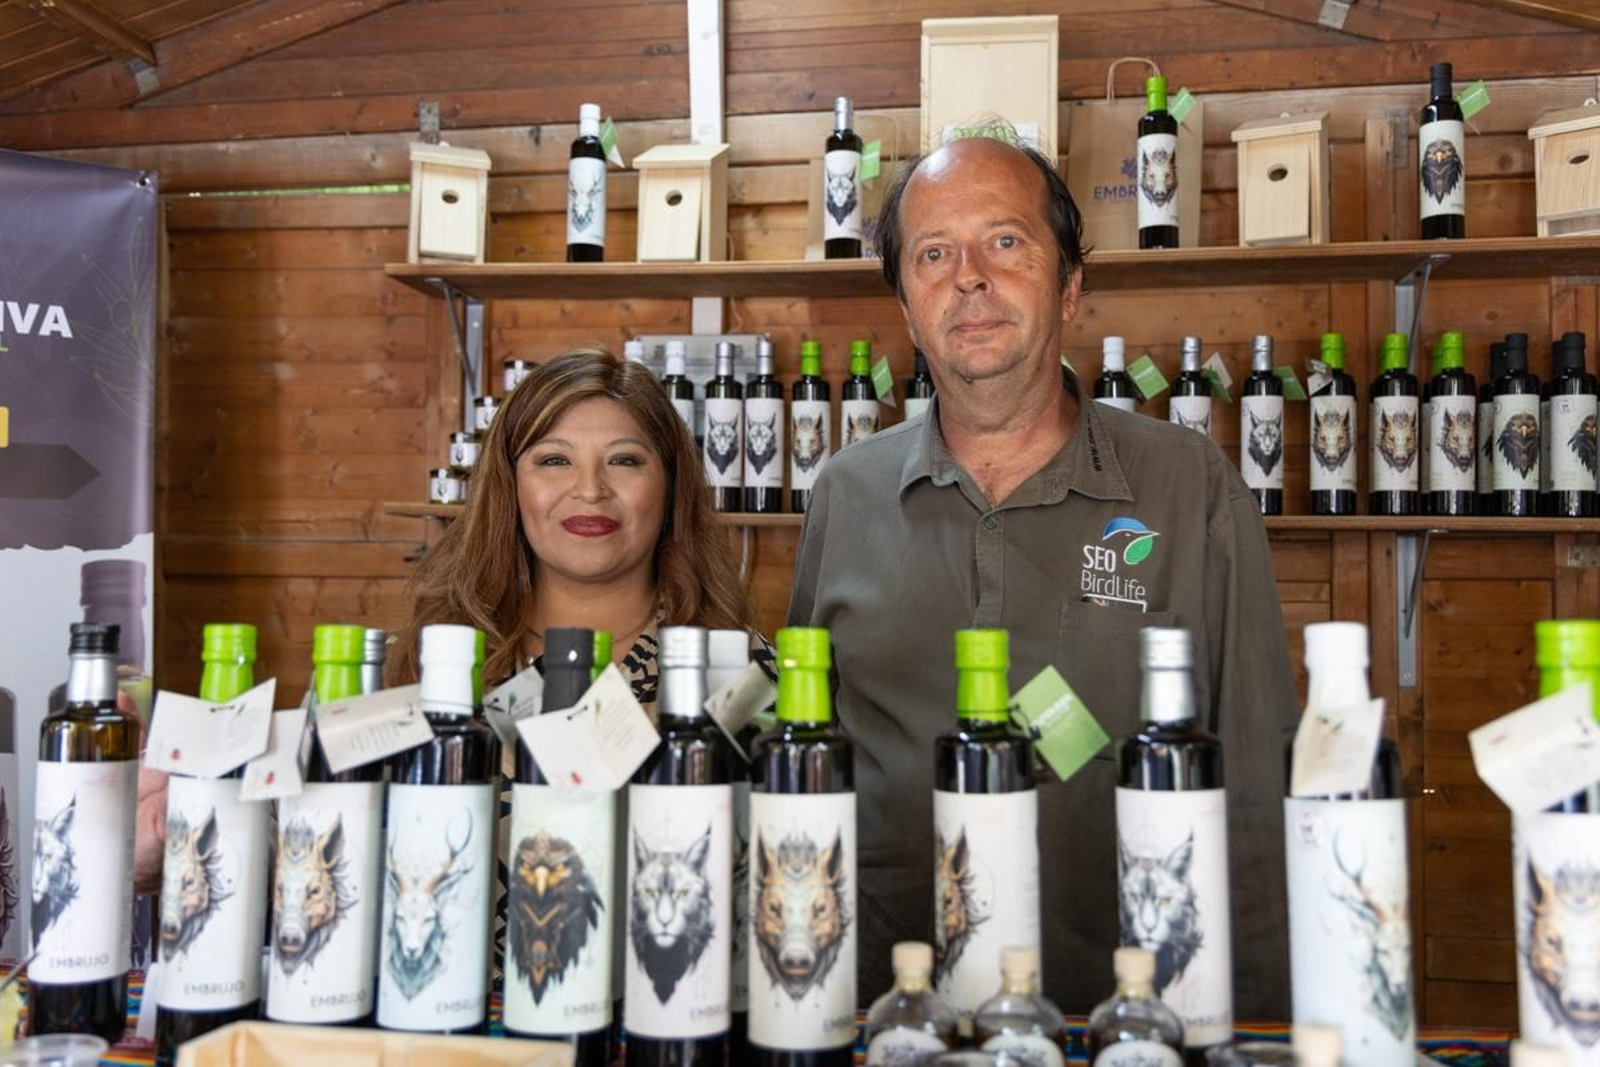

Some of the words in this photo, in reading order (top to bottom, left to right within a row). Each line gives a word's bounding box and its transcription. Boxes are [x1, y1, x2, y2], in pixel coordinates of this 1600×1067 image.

[1082, 544, 1117, 573] SEO
[1080, 569, 1147, 601] BirdLife
[183, 979, 246, 996] EMBRUJO
